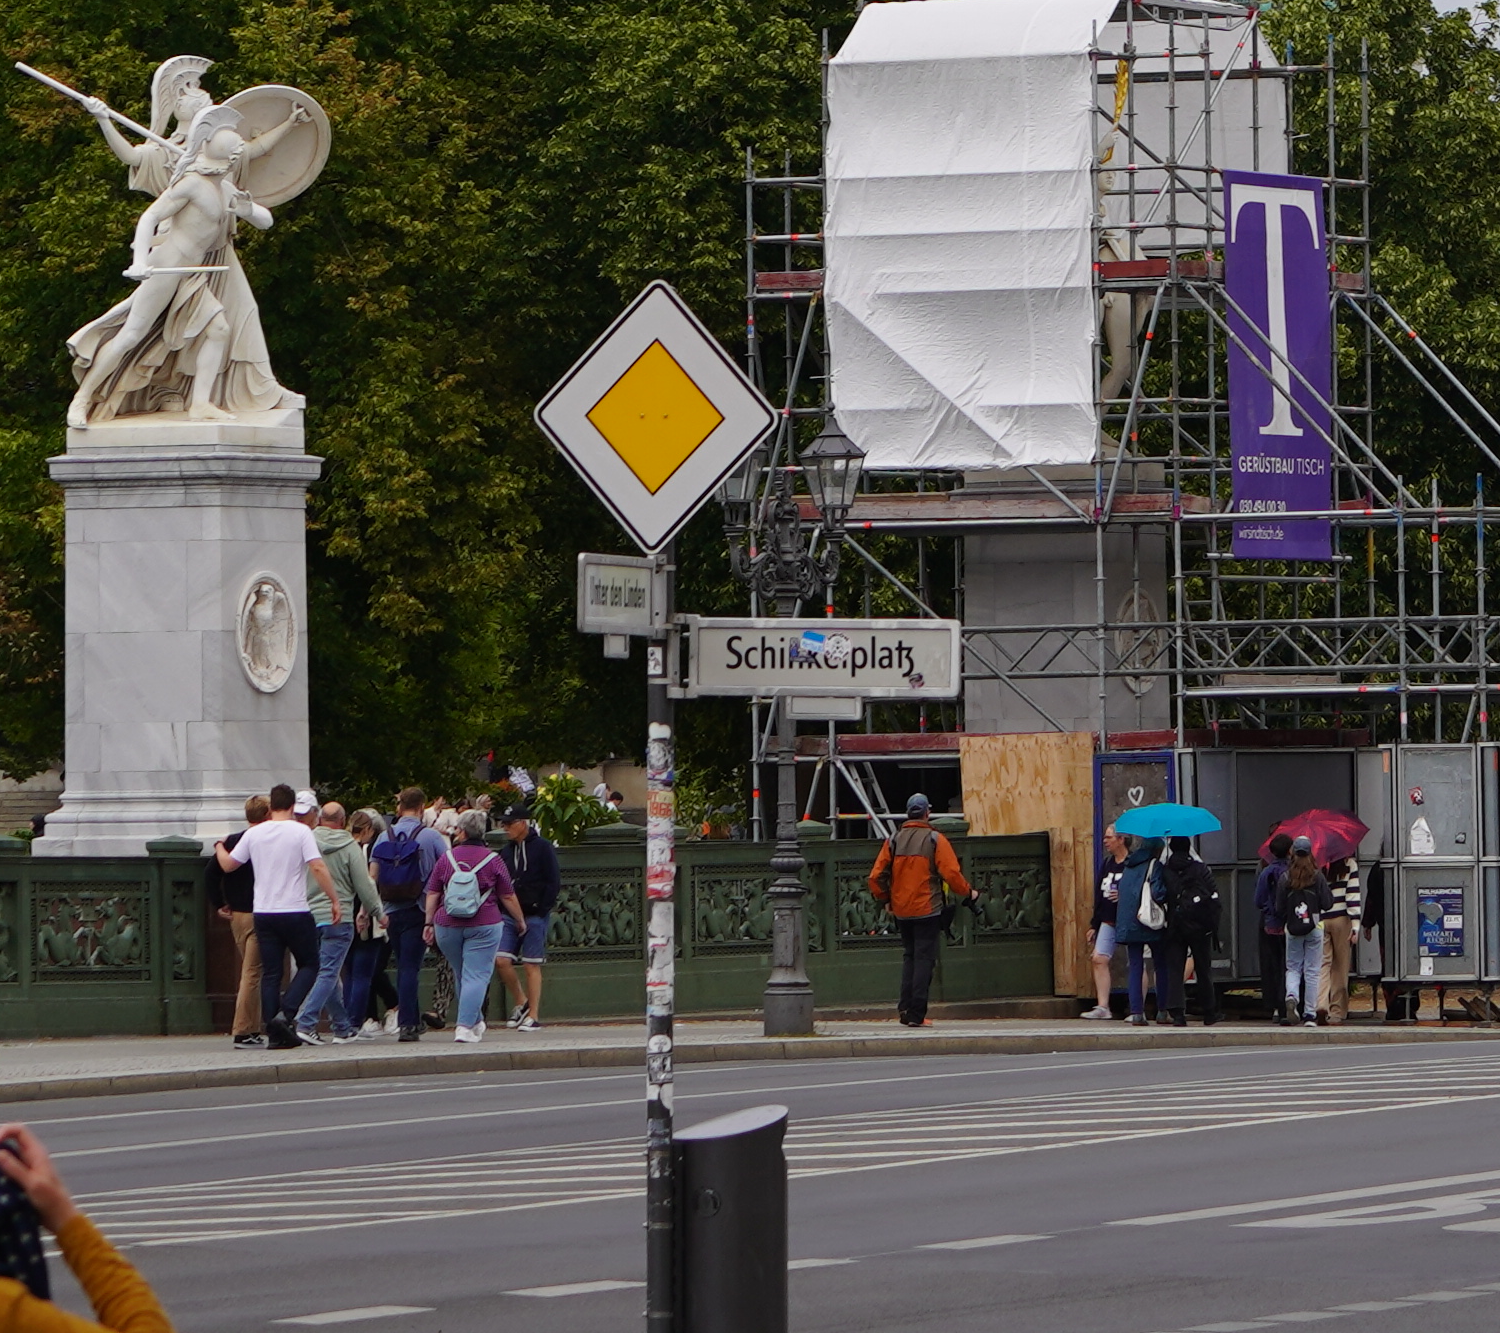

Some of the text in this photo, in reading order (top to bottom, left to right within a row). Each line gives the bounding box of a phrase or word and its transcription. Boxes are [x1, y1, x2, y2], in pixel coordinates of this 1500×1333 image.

[1229, 183, 1320, 437] T
[1238, 452, 1325, 475] GERÜSTBAU TISCH
[1239, 499, 1253, 513] 030
[590, 575, 646, 608] Unter den Linden
[725, 635, 915, 678] Schiplatz
